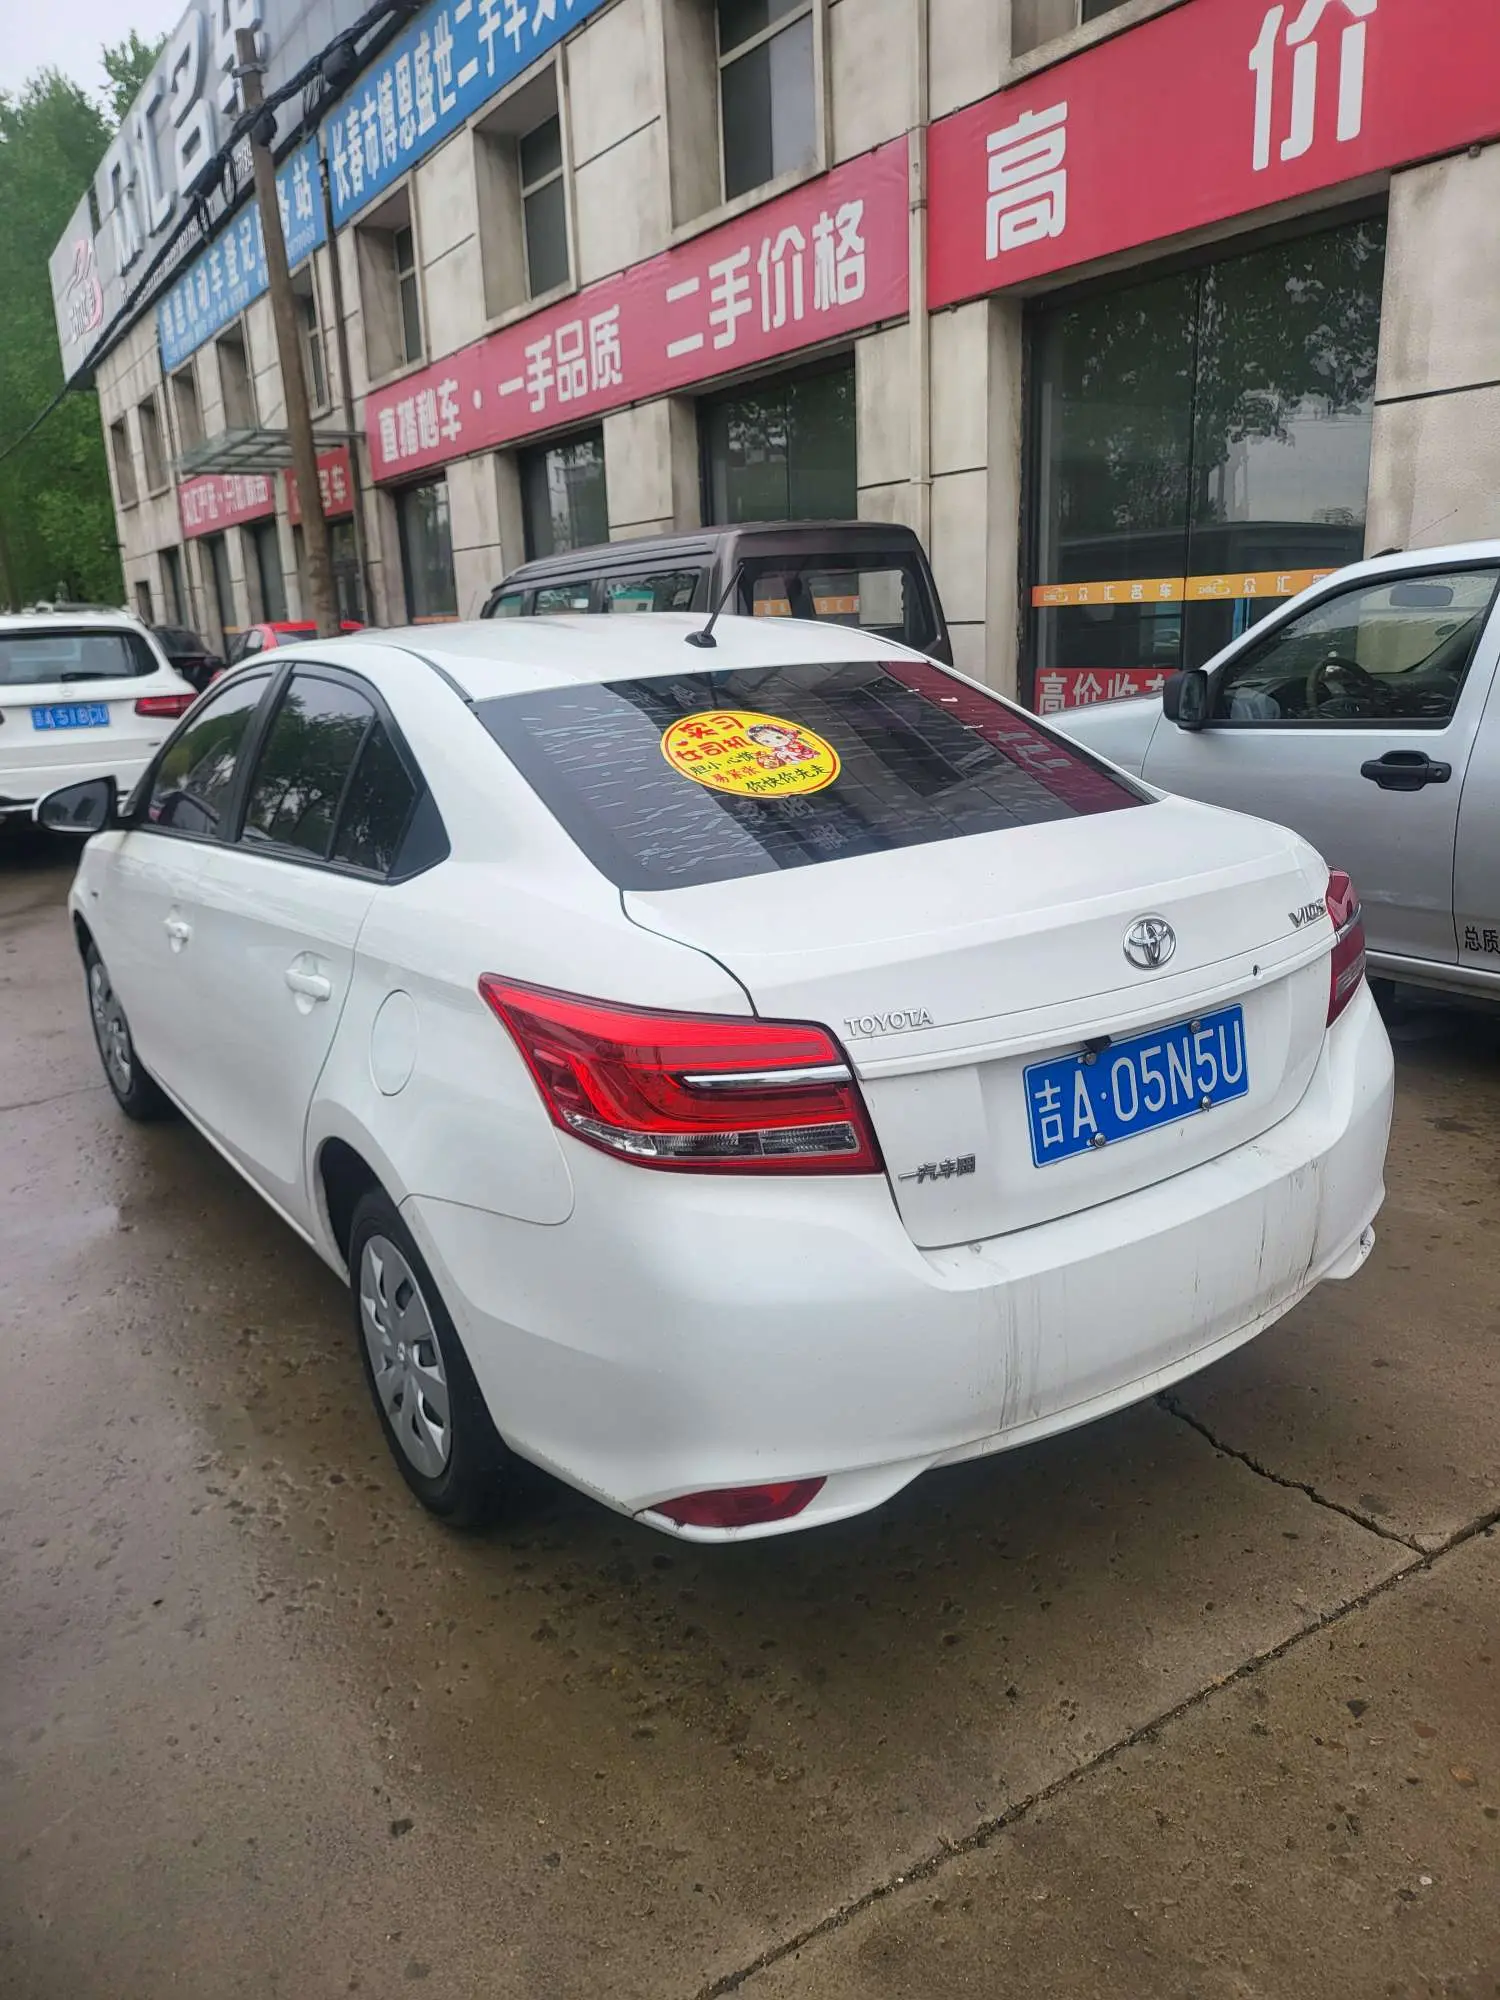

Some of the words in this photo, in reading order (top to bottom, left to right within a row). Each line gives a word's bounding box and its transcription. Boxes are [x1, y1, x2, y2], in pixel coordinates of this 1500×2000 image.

[332, 0, 575, 210] 长春市博恩盛世二手车
[666, 199, 866, 359] 二手价格
[679, 715, 745, 739] 实习
[675, 735, 753, 761] 女司机
[746, 764, 831, 792] 你快你先走
[1464, 926, 1500, 953] 总质
[844, 1007, 934, 1036] TOYOTA
